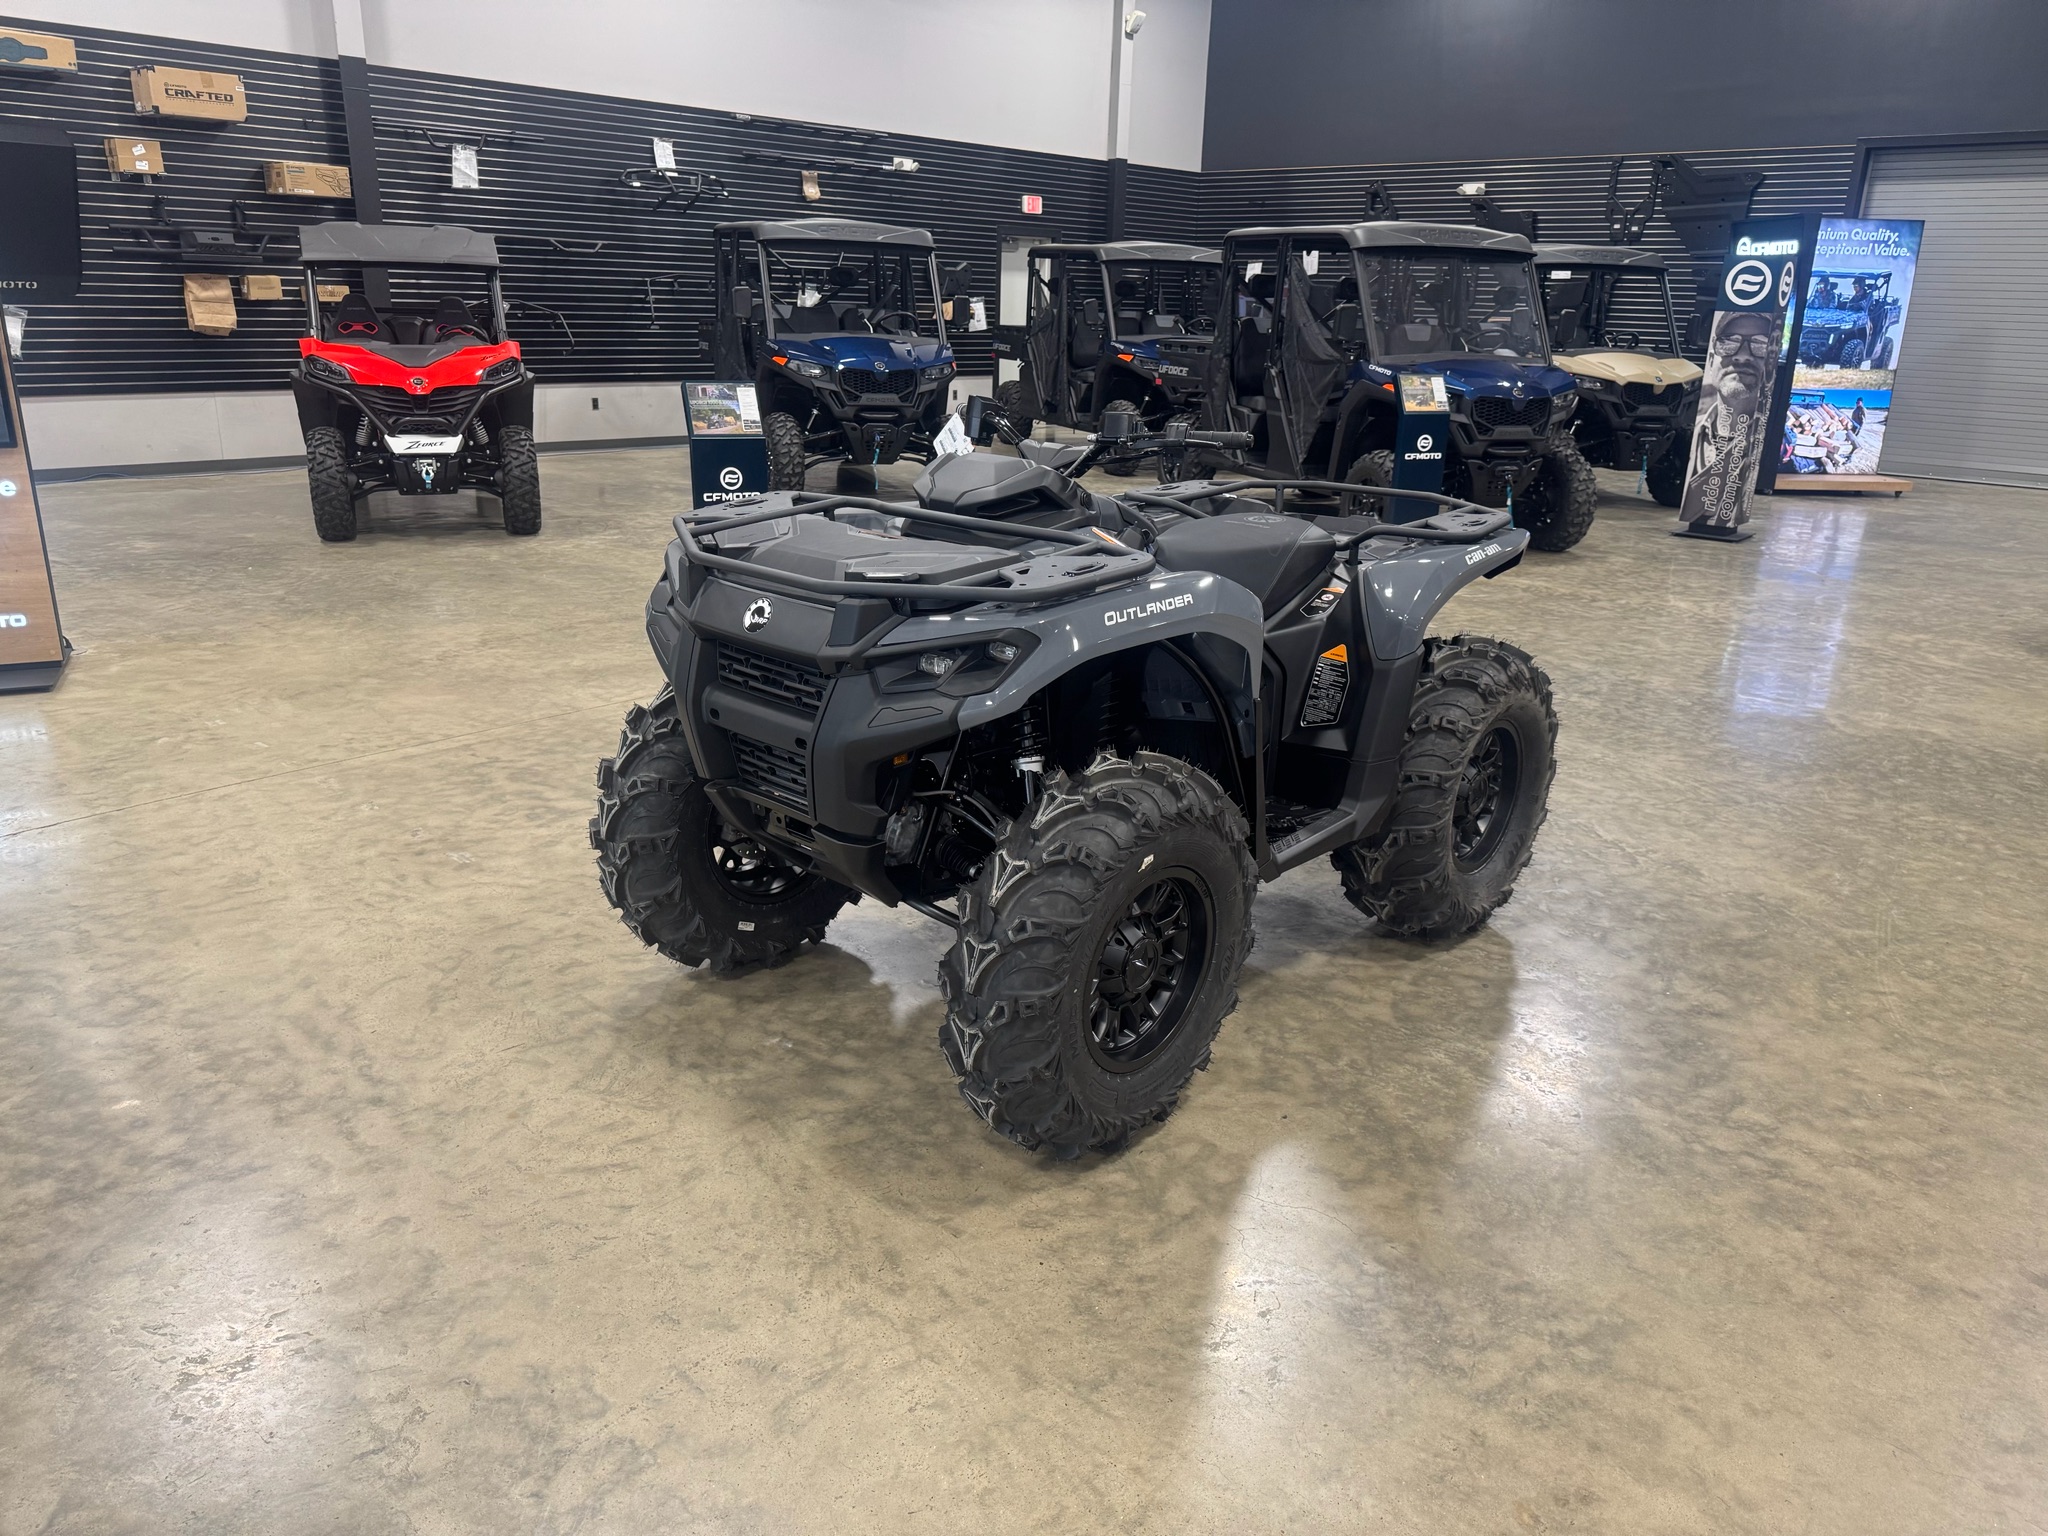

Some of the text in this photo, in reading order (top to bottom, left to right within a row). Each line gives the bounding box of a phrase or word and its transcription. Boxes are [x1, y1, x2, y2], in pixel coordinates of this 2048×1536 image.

[164, 87, 234, 103] CRAFTED
[1851, 228, 1899, 244] Quality.
[1874, 243, 1910, 257] Value.
[1158, 364, 1189, 377] UFORCE
[1368, 364, 1393, 376] CFMOTO
[1404, 452, 1442, 460] CFMOTO
[1702, 404, 1734, 512] ride without
[1720, 413, 1750, 521] compromise
[1464, 543, 1502, 566] can-am
[1104, 593, 1194, 626] OUTLANDER
